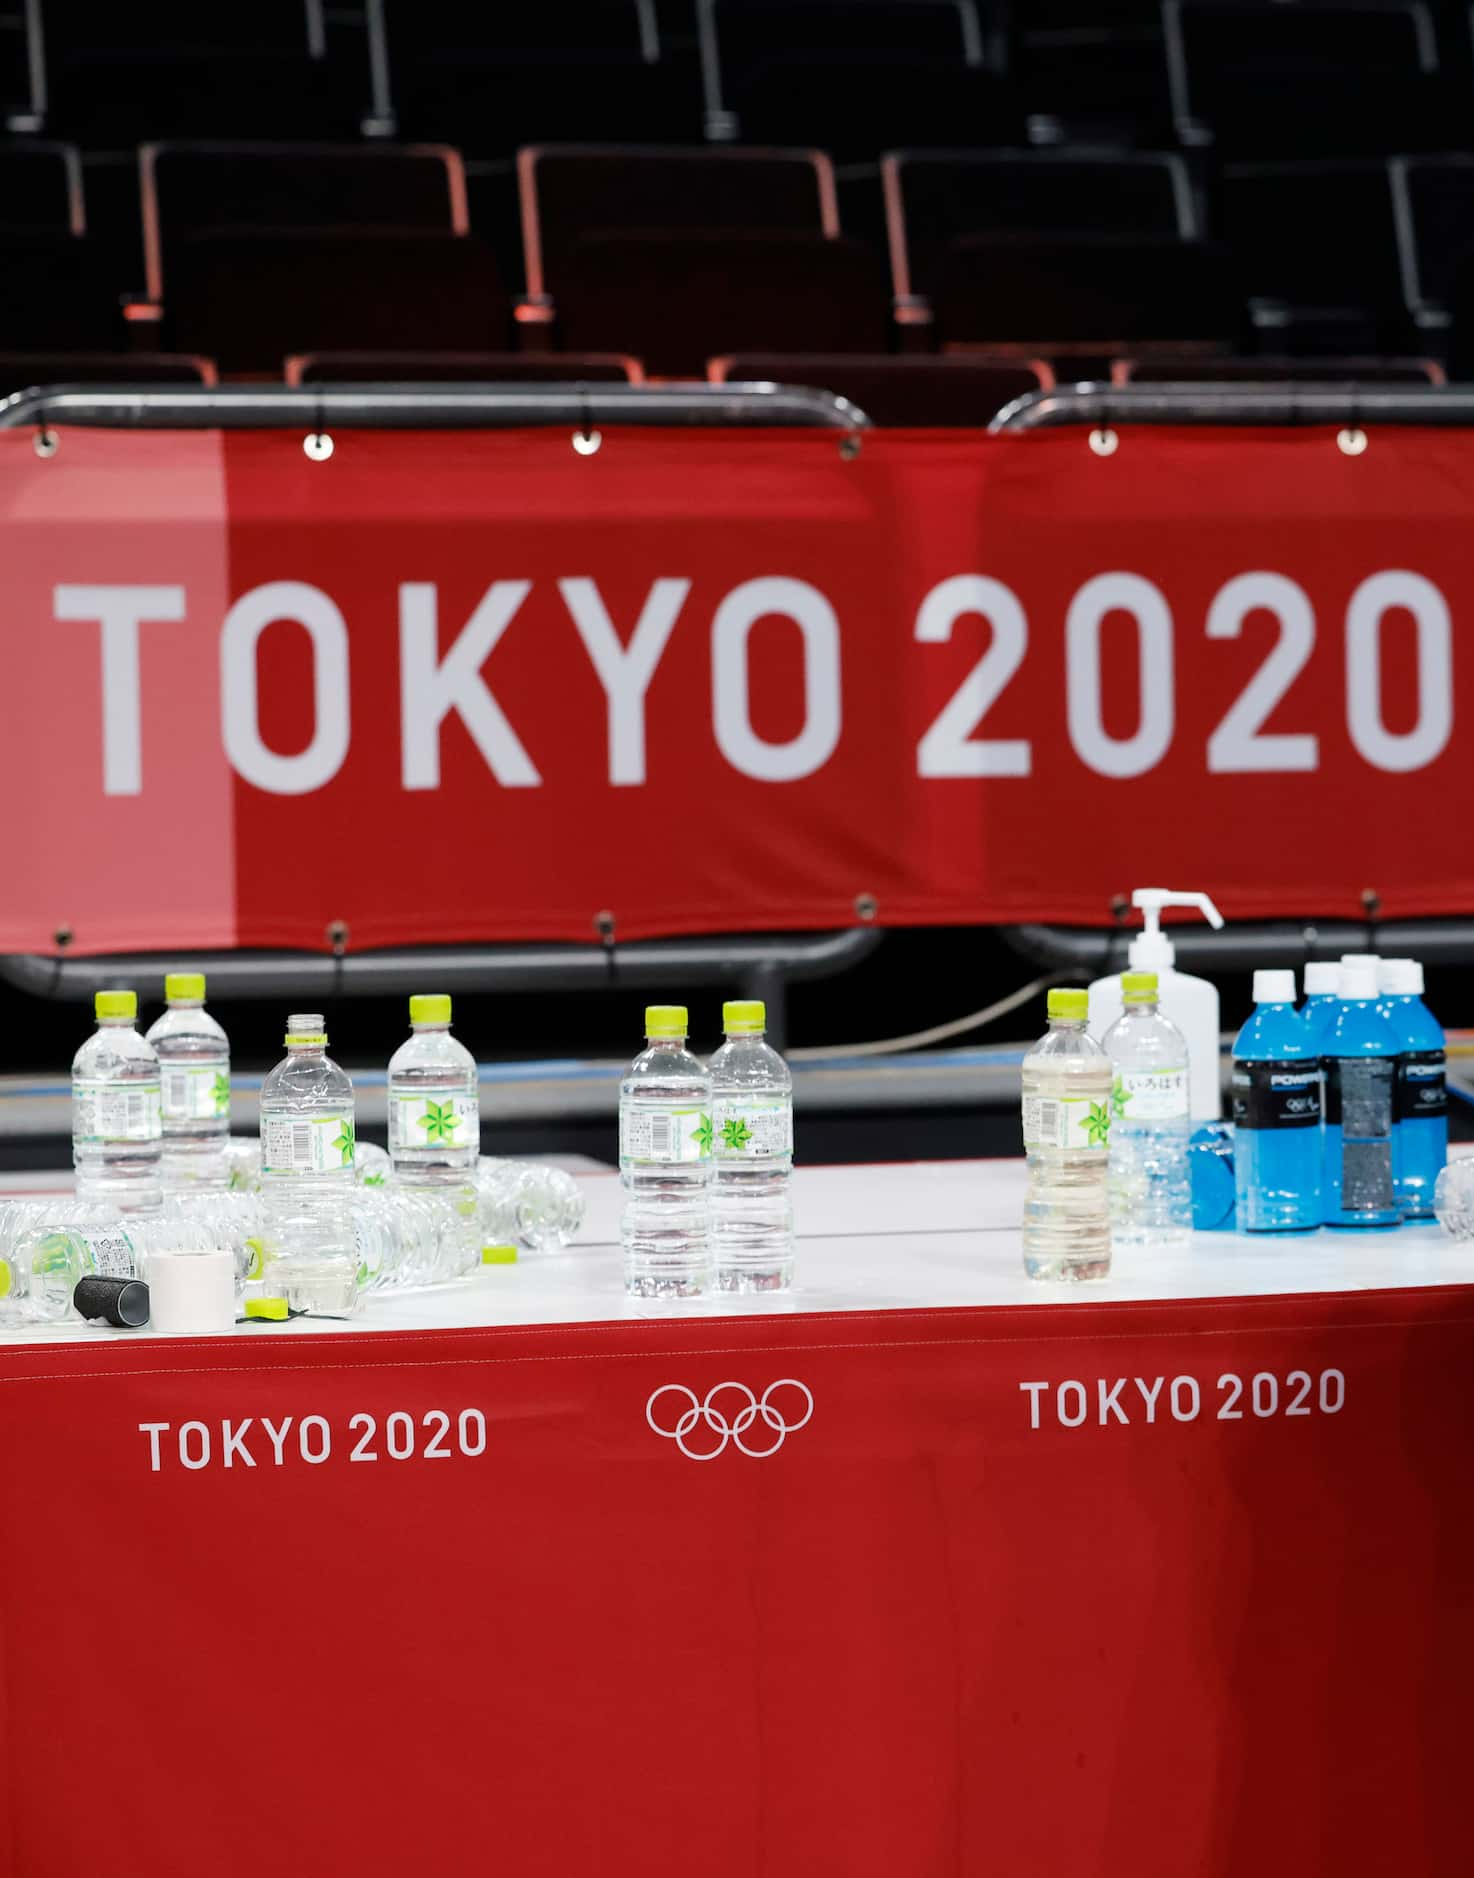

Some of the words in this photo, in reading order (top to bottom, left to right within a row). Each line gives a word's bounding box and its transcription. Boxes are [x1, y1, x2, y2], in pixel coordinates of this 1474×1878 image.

[53, 575, 842, 797] TOKYO
[914, 570, 1453, 778] 2020
[1018, 1375, 1201, 1430] TOKYO
[1216, 1368, 1346, 1420] 2020
[137, 1417, 332, 1472] TOKYO
[347, 1408, 488, 1462] 2020
